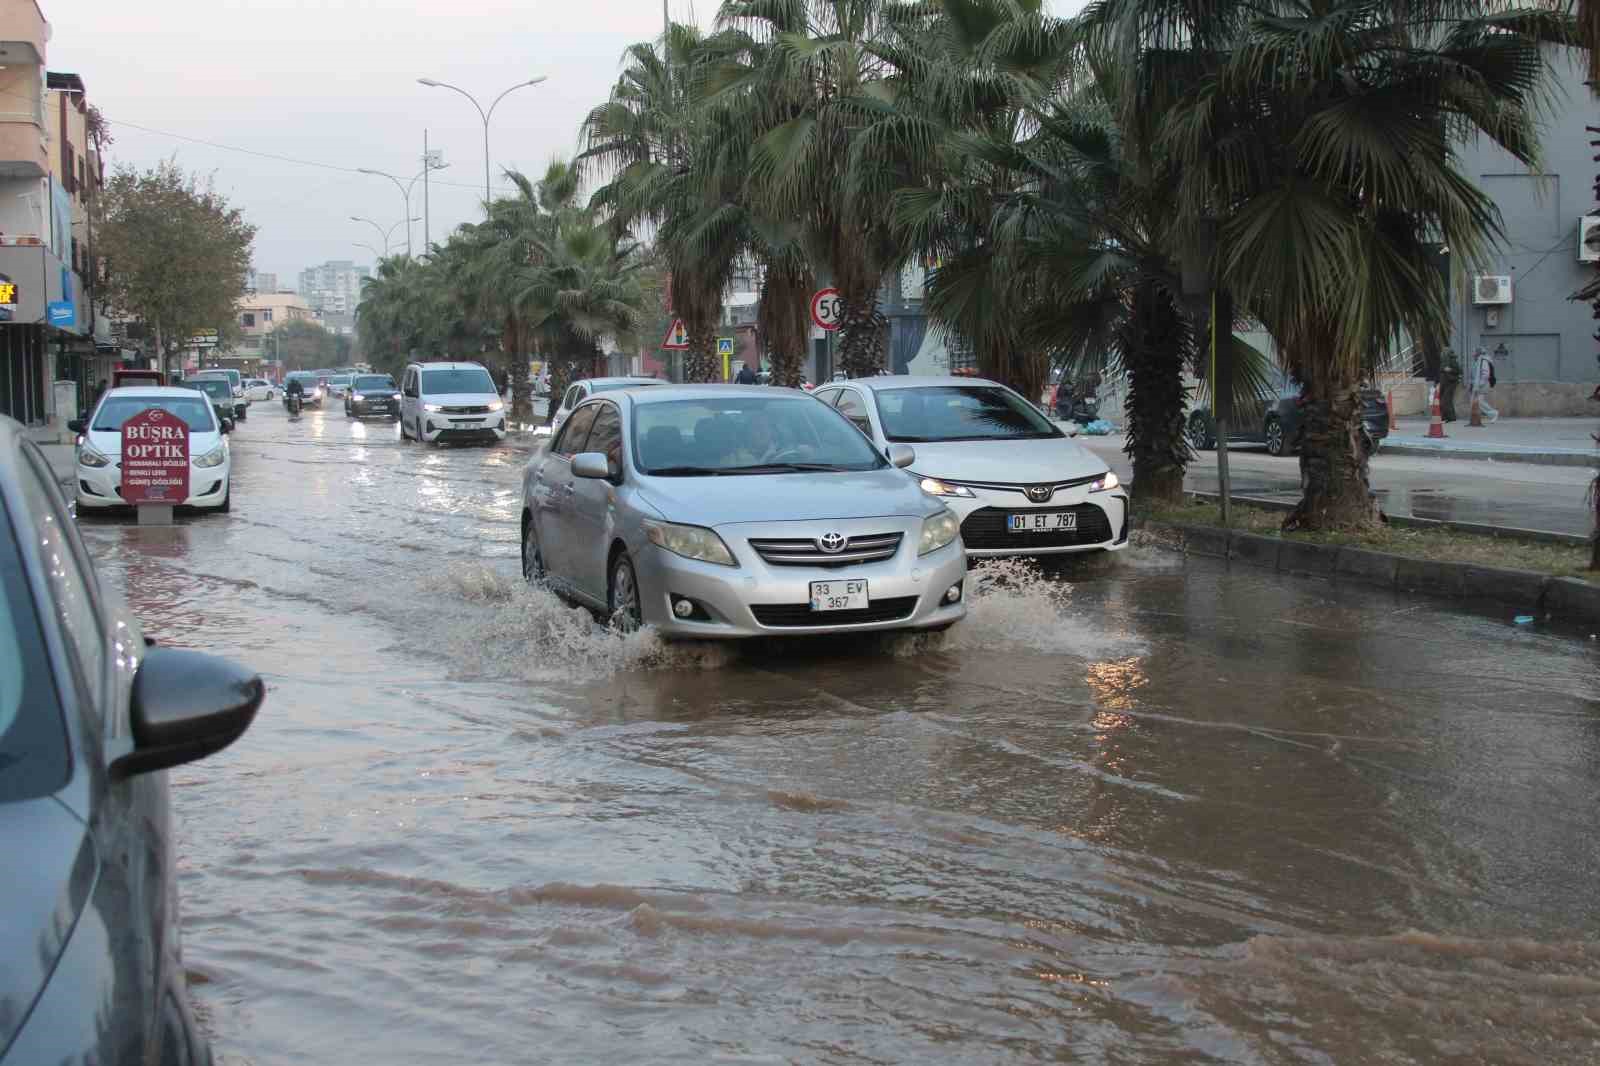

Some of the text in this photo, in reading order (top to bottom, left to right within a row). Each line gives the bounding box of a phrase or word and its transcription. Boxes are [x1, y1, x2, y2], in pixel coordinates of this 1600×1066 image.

[820, 299, 841, 319] 50
[127, 423, 184, 442] BÜŞRA
[128, 442, 184, 457] OPTİK
[1014, 515, 1025, 528] 01
[1035, 515, 1048, 527] ET
[815, 583, 862, 594] 33 EV
[828, 596, 849, 608] 367
